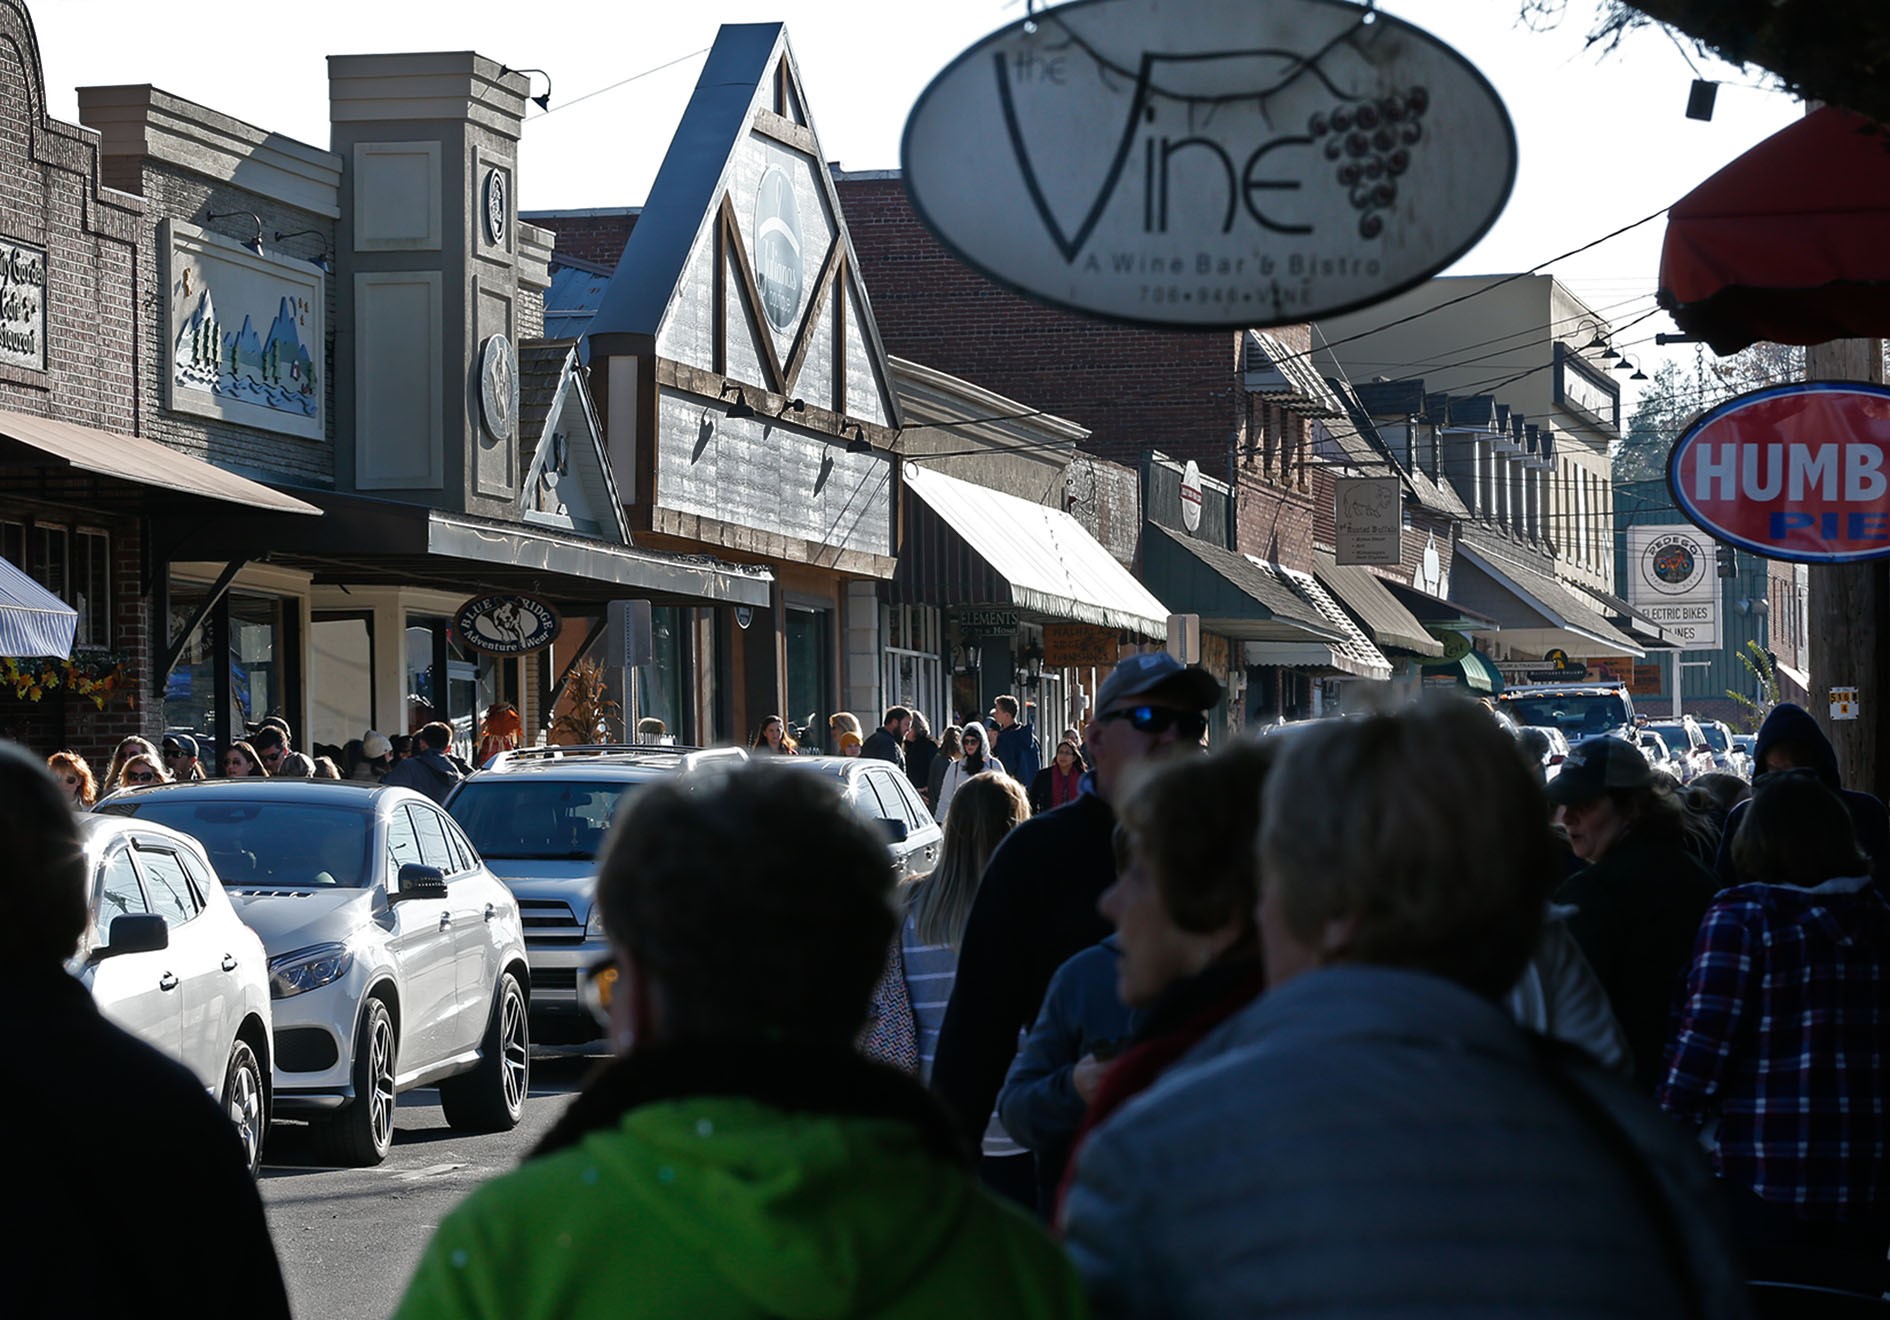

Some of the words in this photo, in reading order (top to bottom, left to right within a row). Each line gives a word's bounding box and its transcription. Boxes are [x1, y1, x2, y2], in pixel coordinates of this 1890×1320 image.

[1013, 50, 1068, 85] the
[1084, 253, 1101, 273] A
[1112, 251, 1185, 275] Wine
[1195, 252, 1244, 275] Bar
[1260, 254, 1276, 276] &
[1287, 252, 1382, 276] Bistro
[1695, 442, 1888, 502] HUMB
[1769, 511, 1889, 541] PIE
[1648, 536, 1698, 555] PEDEGO
[460, 599, 493, 629] BLUE
[961, 611, 1018, 625] ELEMENTS
[1682, 606, 1708, 620] BIKES
[463, 630, 518, 652] Adventure
[526, 631, 550, 648] Wear
